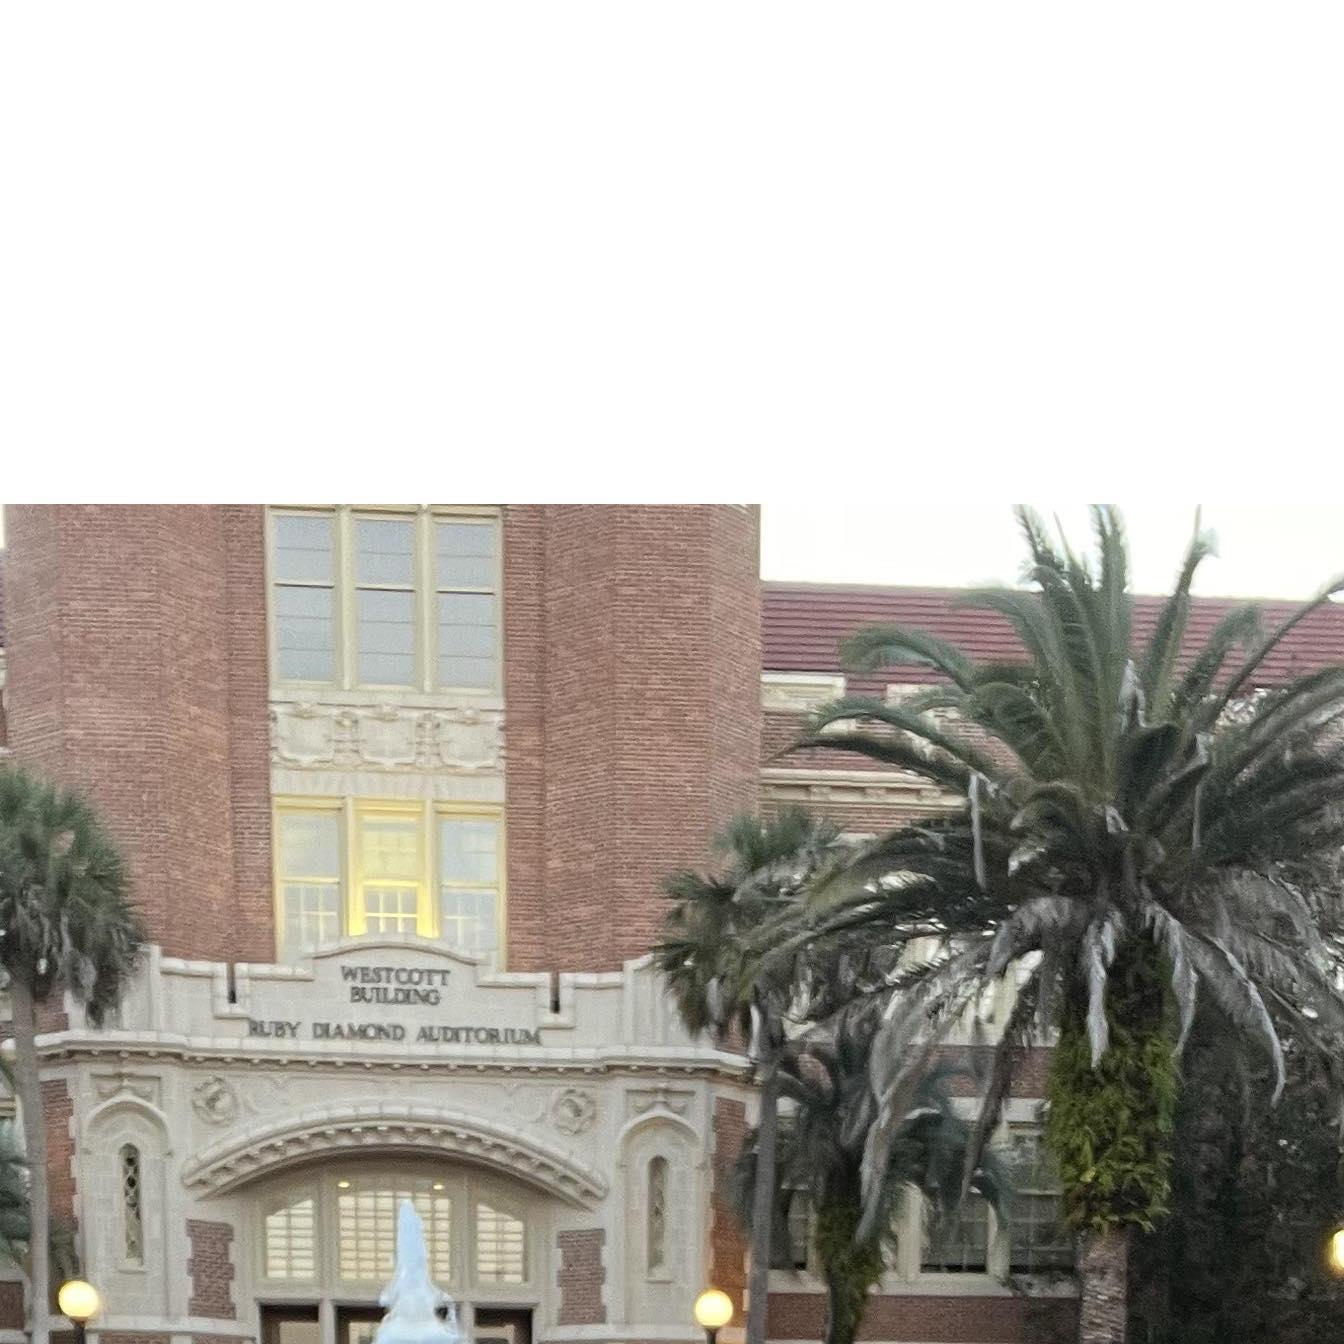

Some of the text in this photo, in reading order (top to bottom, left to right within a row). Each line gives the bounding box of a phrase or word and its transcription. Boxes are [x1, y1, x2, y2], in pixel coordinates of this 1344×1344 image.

[340, 965, 451, 986] WESTCOTT
[349, 986, 441, 1006] BUILDING
[248, 1020, 543, 1045] RUBY DIAMOND AUDITORIUM
